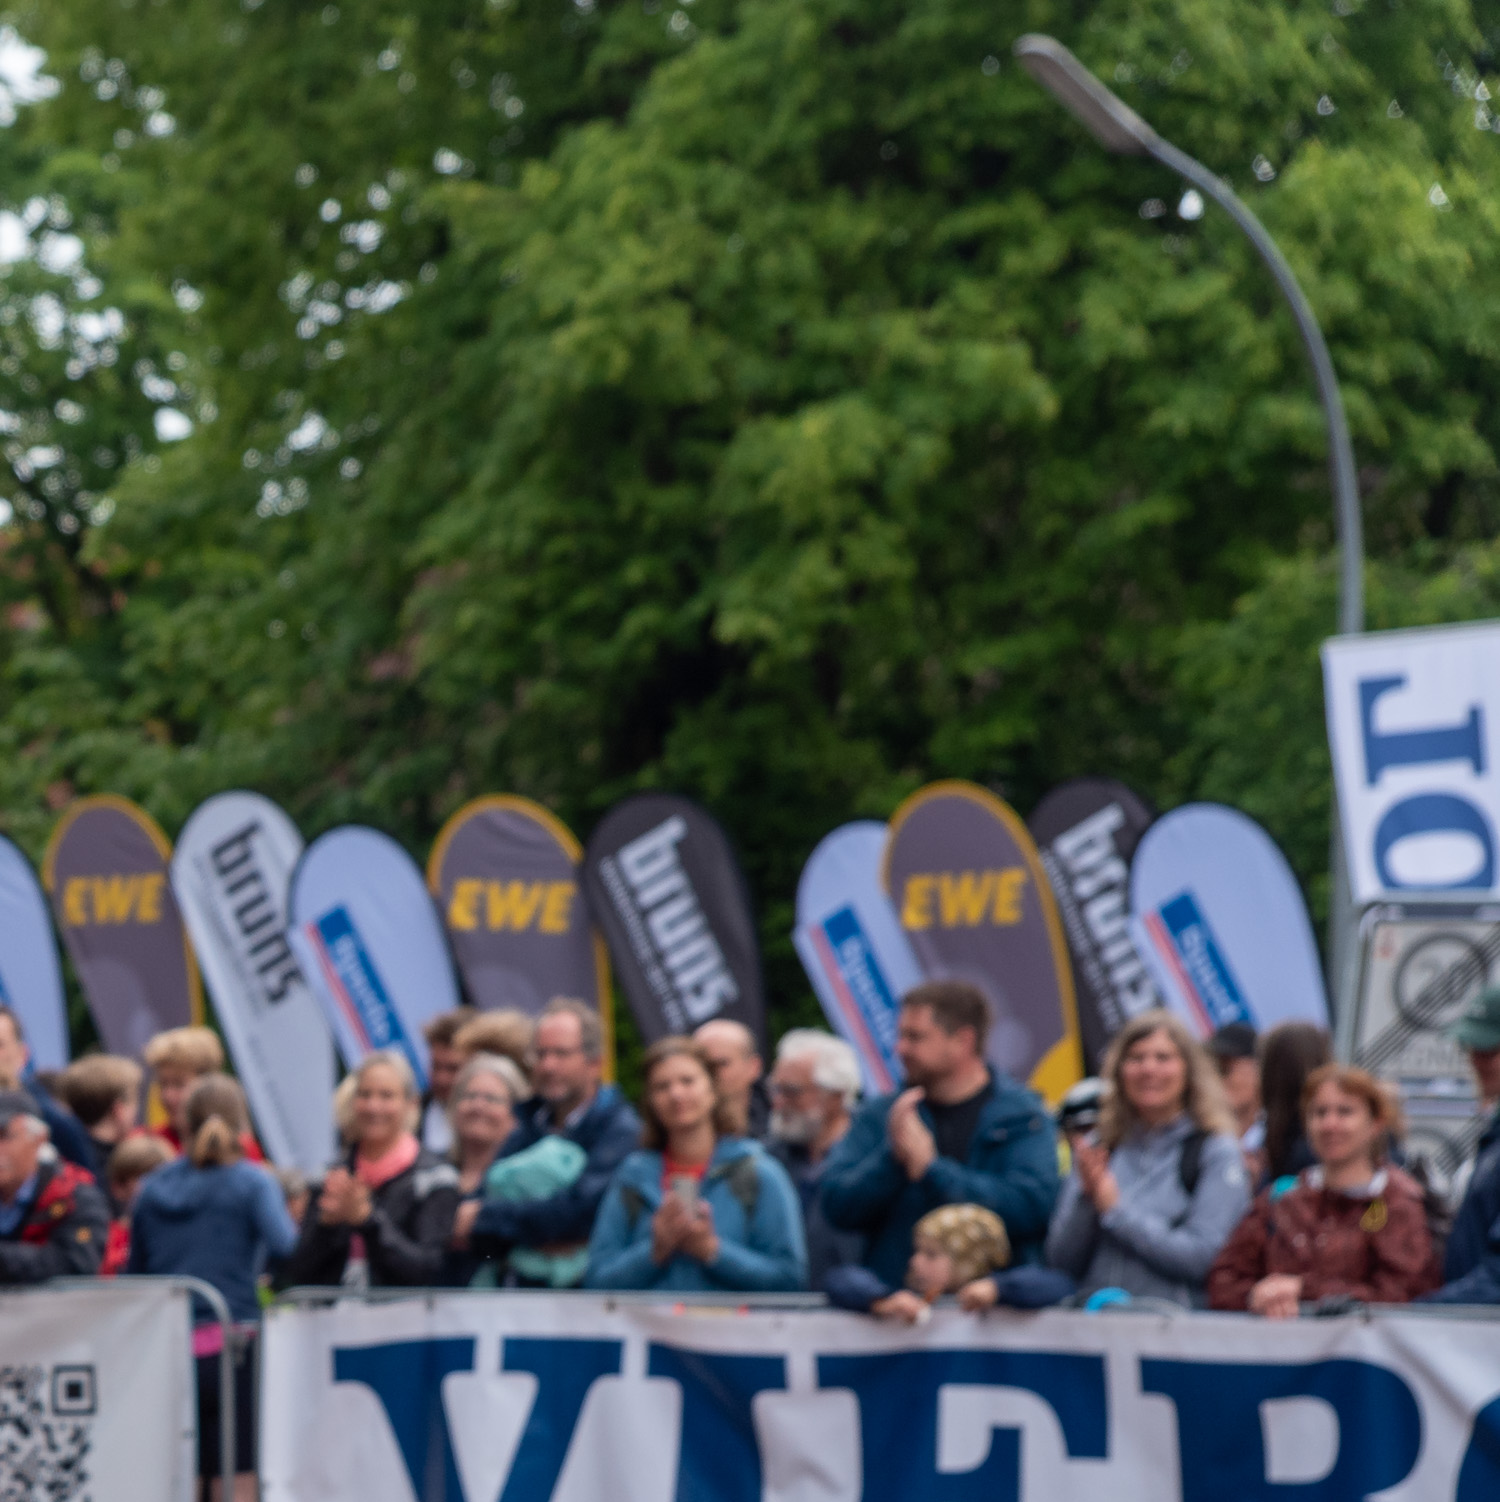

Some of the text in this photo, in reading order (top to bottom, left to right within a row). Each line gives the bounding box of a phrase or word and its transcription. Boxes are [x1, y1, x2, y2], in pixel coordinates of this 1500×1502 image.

[63, 873, 166, 926] EWE
[211, 819, 303, 1006] bruns
[448, 879, 576, 934] EWE
[620, 815, 740, 1021] bruns
[903, 867, 1025, 931] EWE
